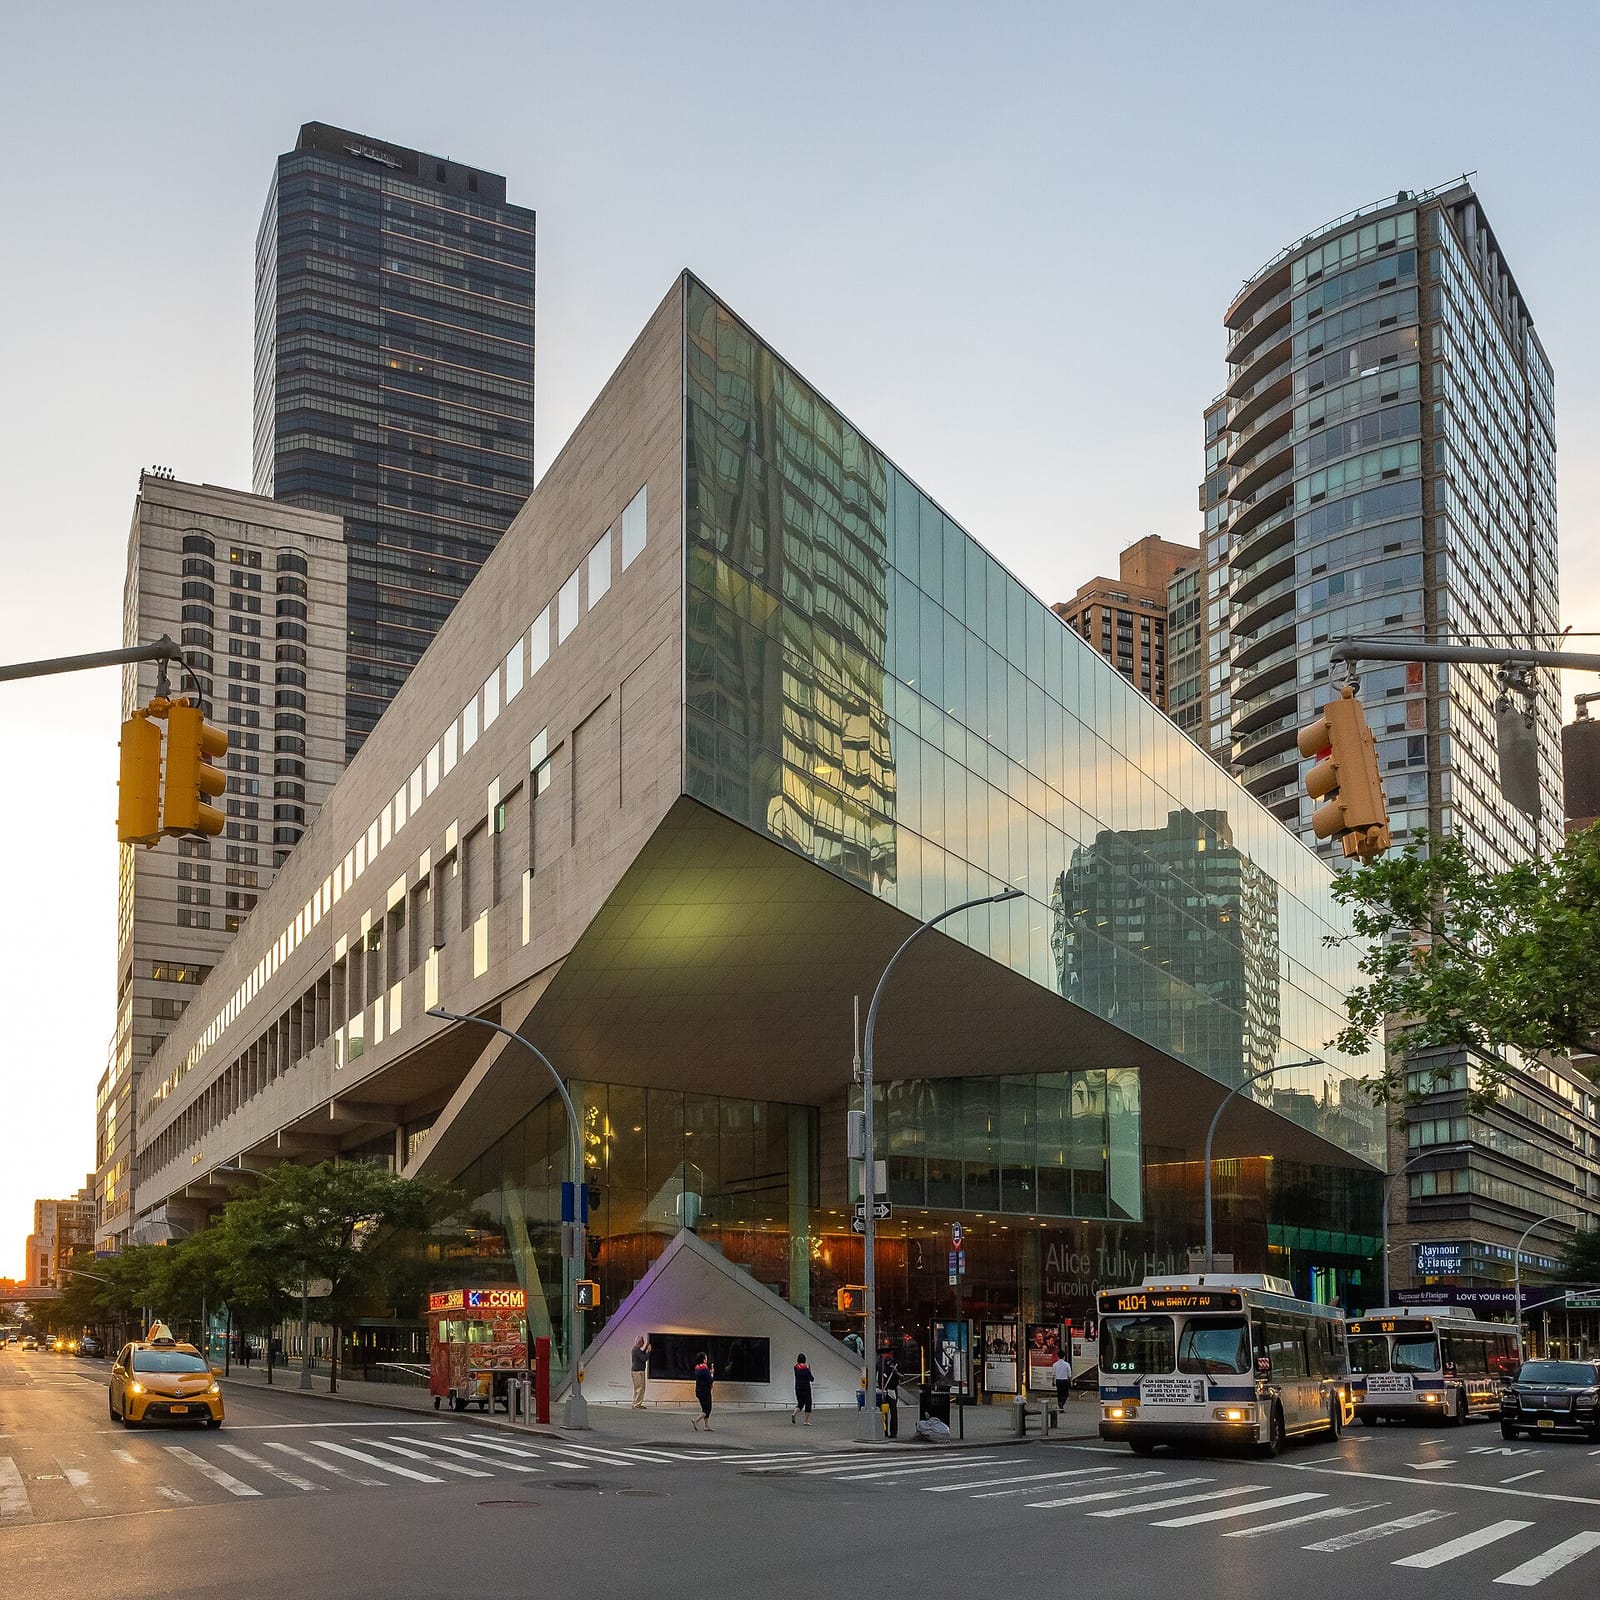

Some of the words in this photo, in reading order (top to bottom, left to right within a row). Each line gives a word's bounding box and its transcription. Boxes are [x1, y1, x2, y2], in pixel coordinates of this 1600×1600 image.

[1045, 1243, 1090, 1274] Alice
[1096, 1247, 1138, 1284] Tully
[1144, 1251, 1175, 1276] Hall
[1418, 1256, 1424, 1269] &
[1046, 1276, 1088, 1297] Lincoln
[1118, 1295, 1147, 1310] M104
[1166, 1297, 1197, 1306] BWAY/7
[1199, 1297, 1210, 1305] AV
[1456, 1293, 1477, 1301] LOVE
[1479, 1293, 1501, 1301] YOUR
